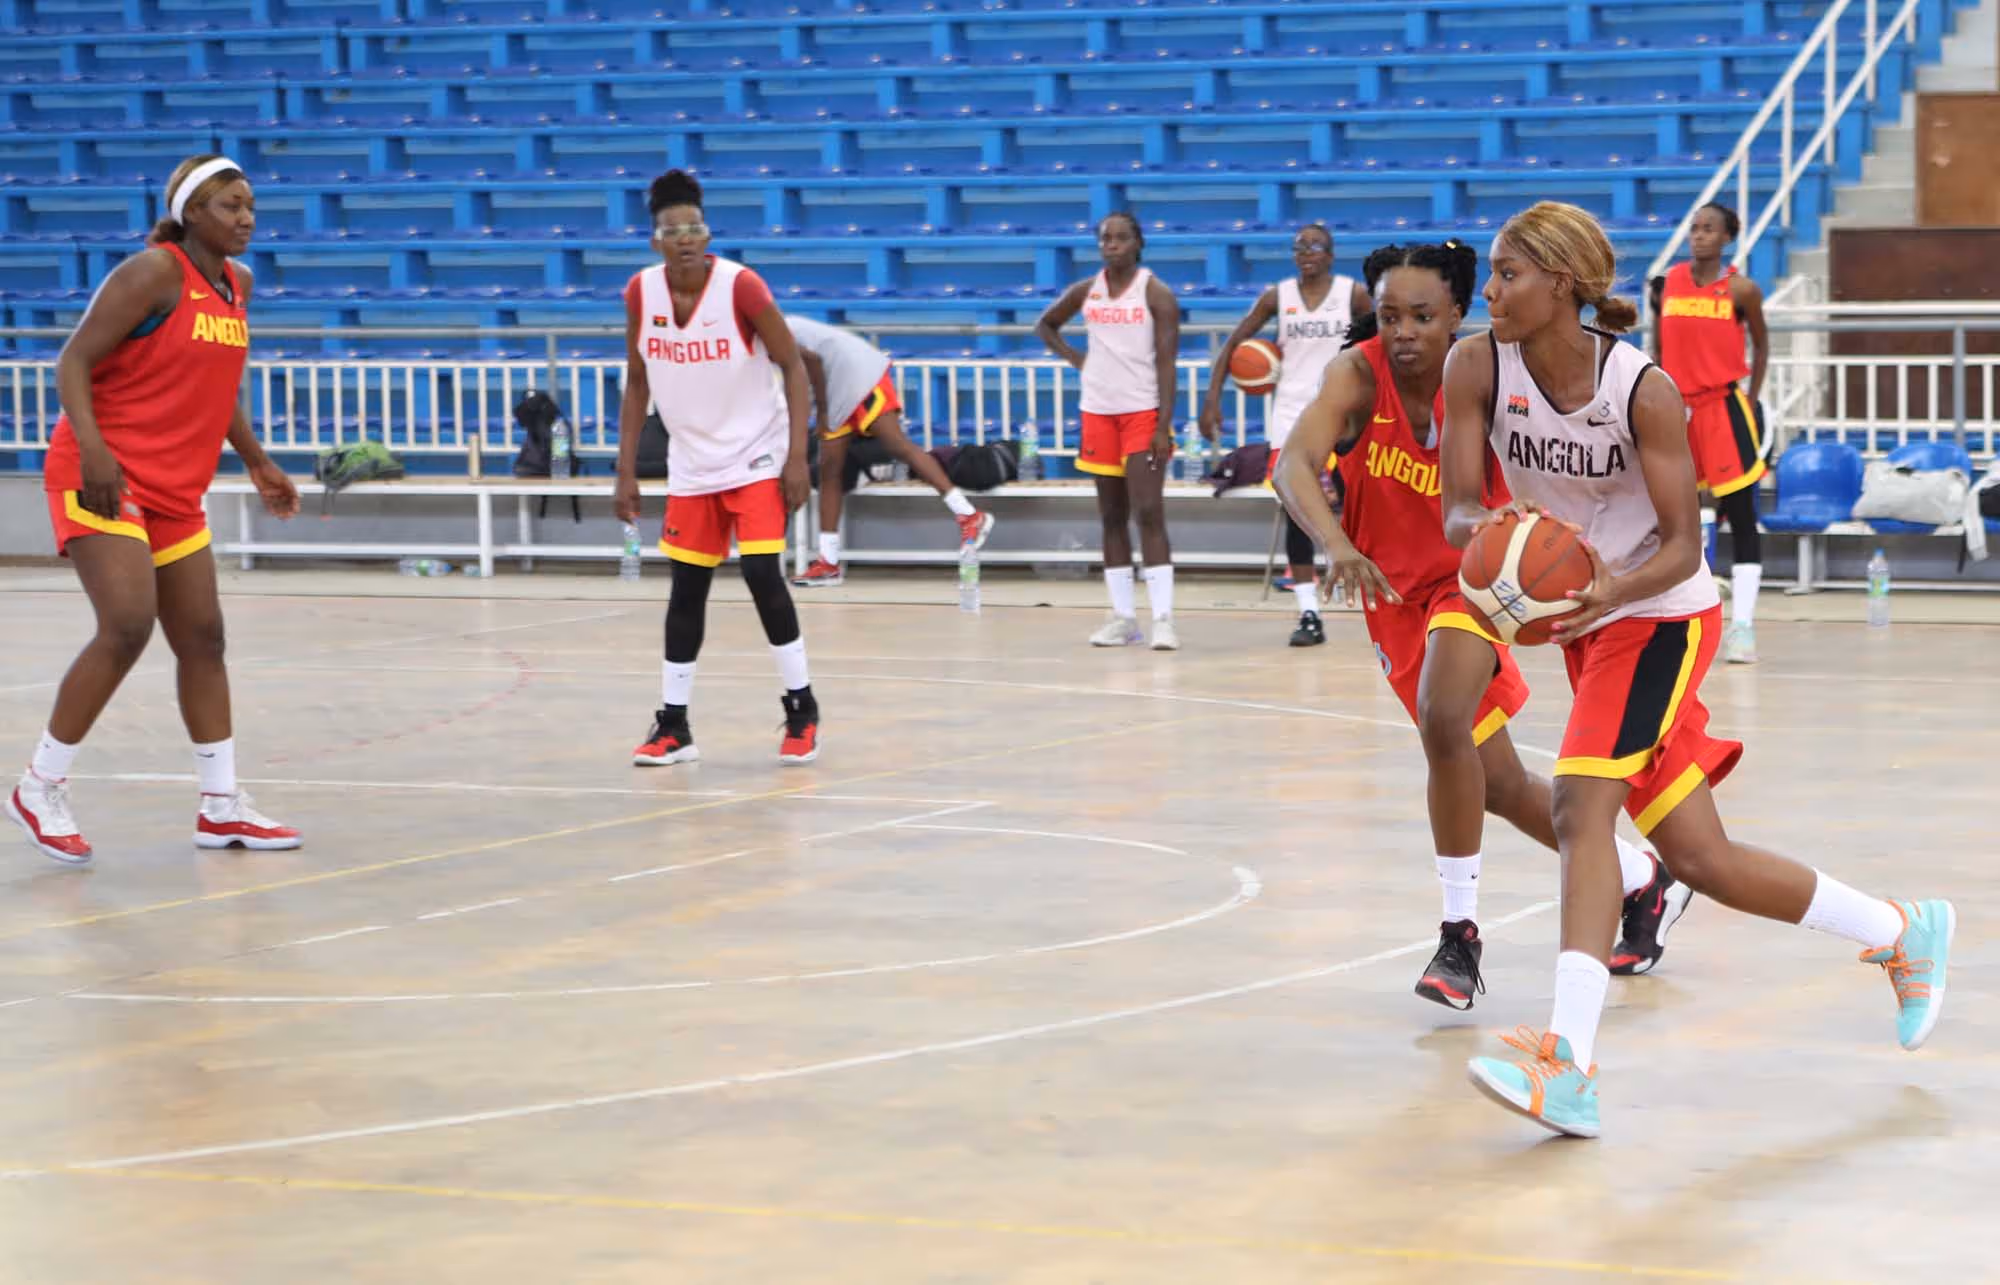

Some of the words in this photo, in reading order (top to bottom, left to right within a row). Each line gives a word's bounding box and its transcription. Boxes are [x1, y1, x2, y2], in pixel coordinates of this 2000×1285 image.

[192, 312, 248, 347] ANGOL
[648, 338, 730, 363] ANGOLA
[1366, 441, 1441, 496] ANGOL
[1508, 431, 1626, 478] ANGOLA
